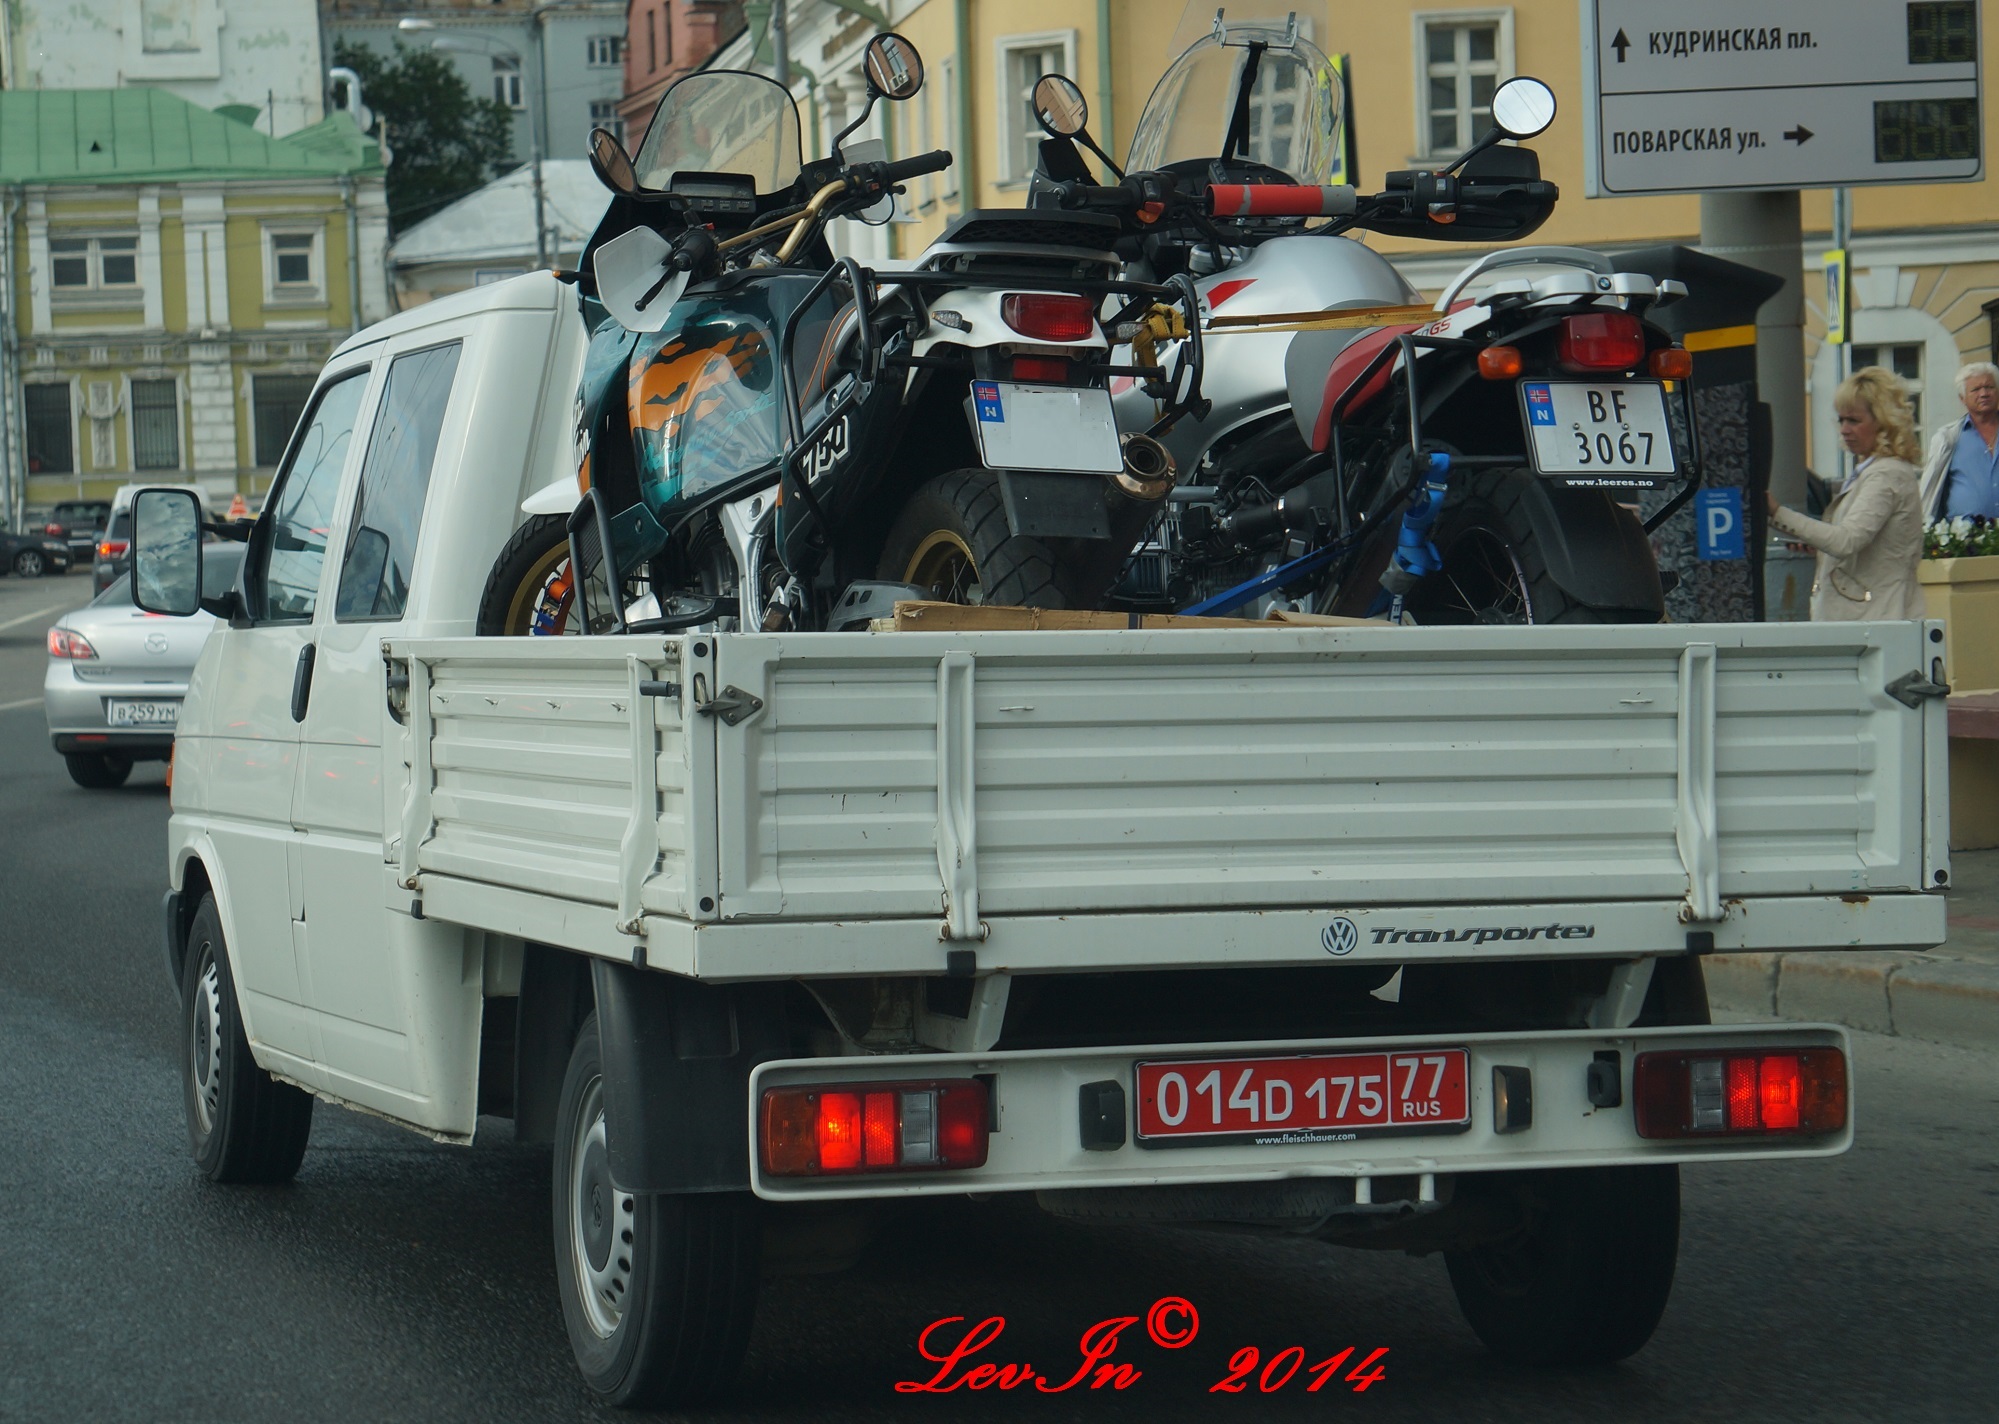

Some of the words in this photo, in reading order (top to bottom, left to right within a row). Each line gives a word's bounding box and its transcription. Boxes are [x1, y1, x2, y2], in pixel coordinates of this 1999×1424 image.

[1649, 27, 1782, 58] КУДРИНСКАЯ
[1787, 32, 1818, 49] пл.
[1613, 127, 1732, 154] ПОВАРСКАЯ
[1737, 131, 1766, 155] ул.
[1537, 410, 1549, 421] N
[1586, 390, 1628, 423] BF
[1573, 432, 1654, 465] 3067
[1565, 478, 1654, 487] www.leeres.no
[1707, 507, 1733, 548] P
[1395, 1056, 1447, 1100] 77
[1403, 1101, 1441, 1117] RUS
[1255, 1131, 1357, 1146] www.fleischhauer.com
